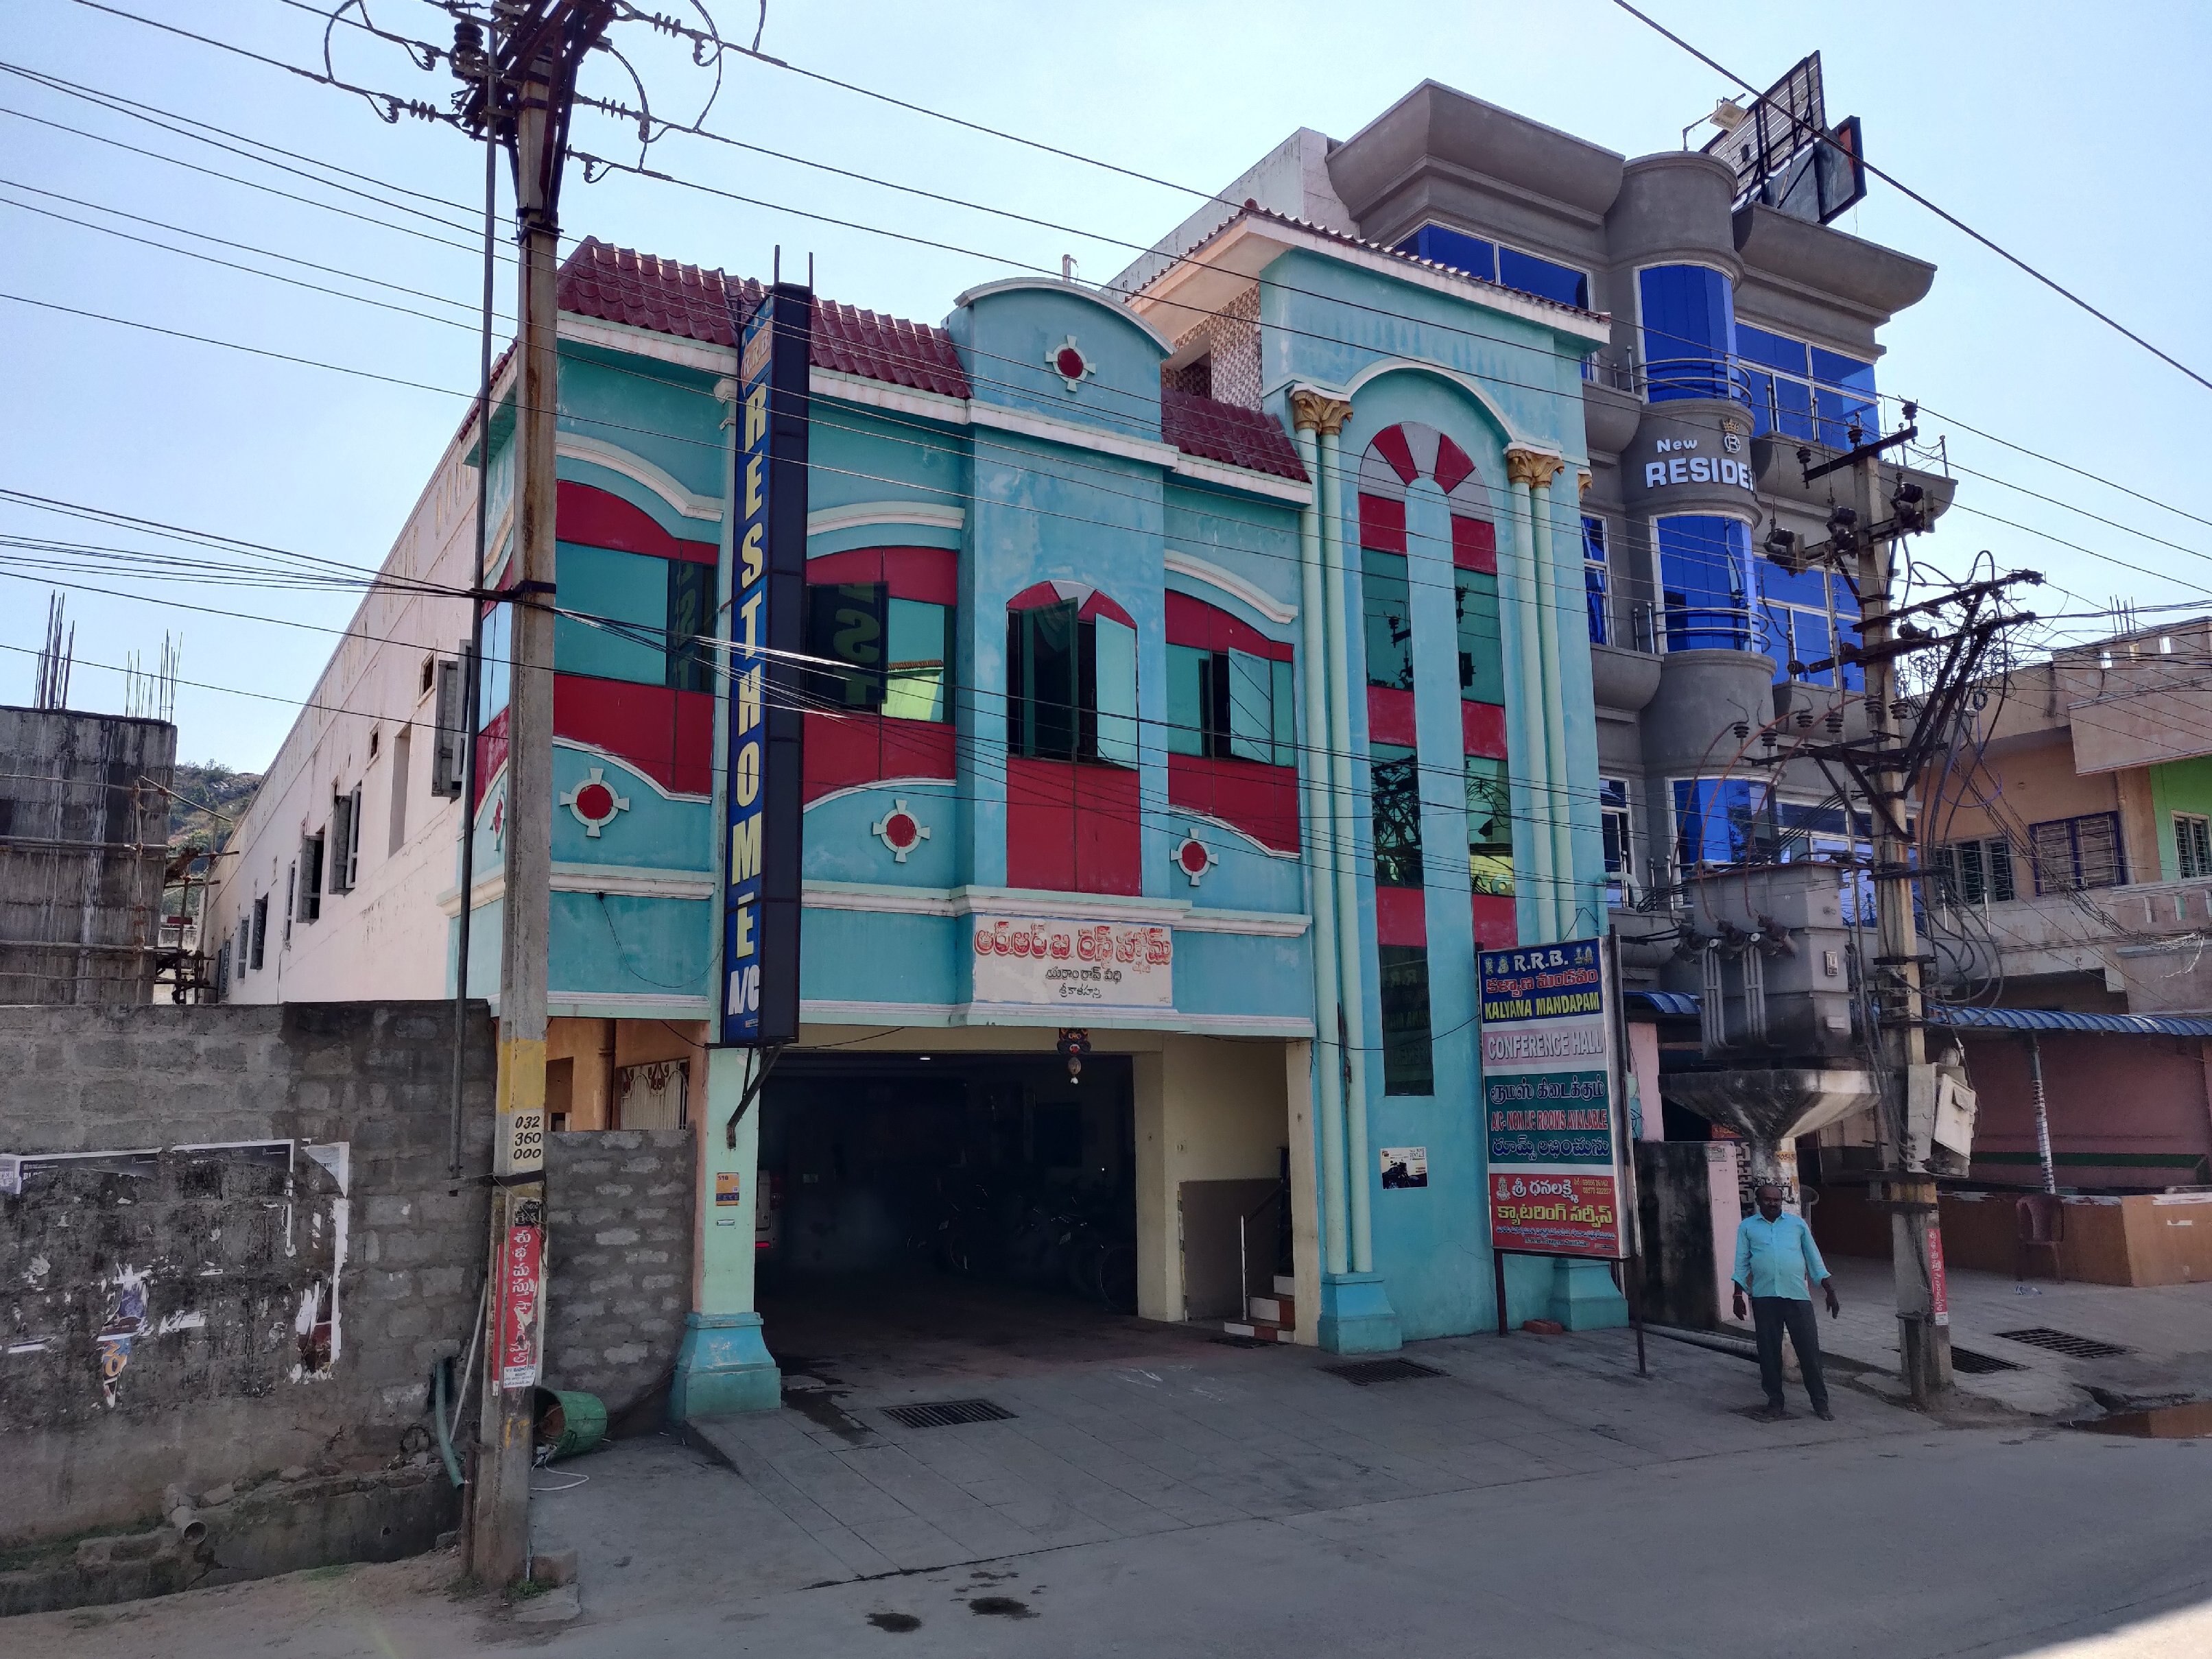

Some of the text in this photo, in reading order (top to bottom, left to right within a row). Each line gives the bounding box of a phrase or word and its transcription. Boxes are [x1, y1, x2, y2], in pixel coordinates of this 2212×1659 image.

[1656, 438, 1698, 453] New
[1514, 950, 1569, 972] R.R.B.
[728, 964, 760, 1016] A/C
[1486, 968, 1598, 997] కళ్యాణ మండపం
[1485, 992, 1600, 1020] KALYANA MANDAPAM
[1488, 1030, 1603, 1060] CONFERENCE HALL
[1537, 1074, 1606, 1101] கிடைக்கும்
[515, 1114, 540, 1130] 032
[1537, 1110, 1567, 1131] ROOMS
[1567, 1109, 1608, 1130] AVAILABLE
[514, 1130, 542, 1145] 360
[1538, 1137, 1610, 1158] లభించును
[513, 1147, 542, 1160] 000
[1512, 1178, 1527, 1197] శ్రీ
